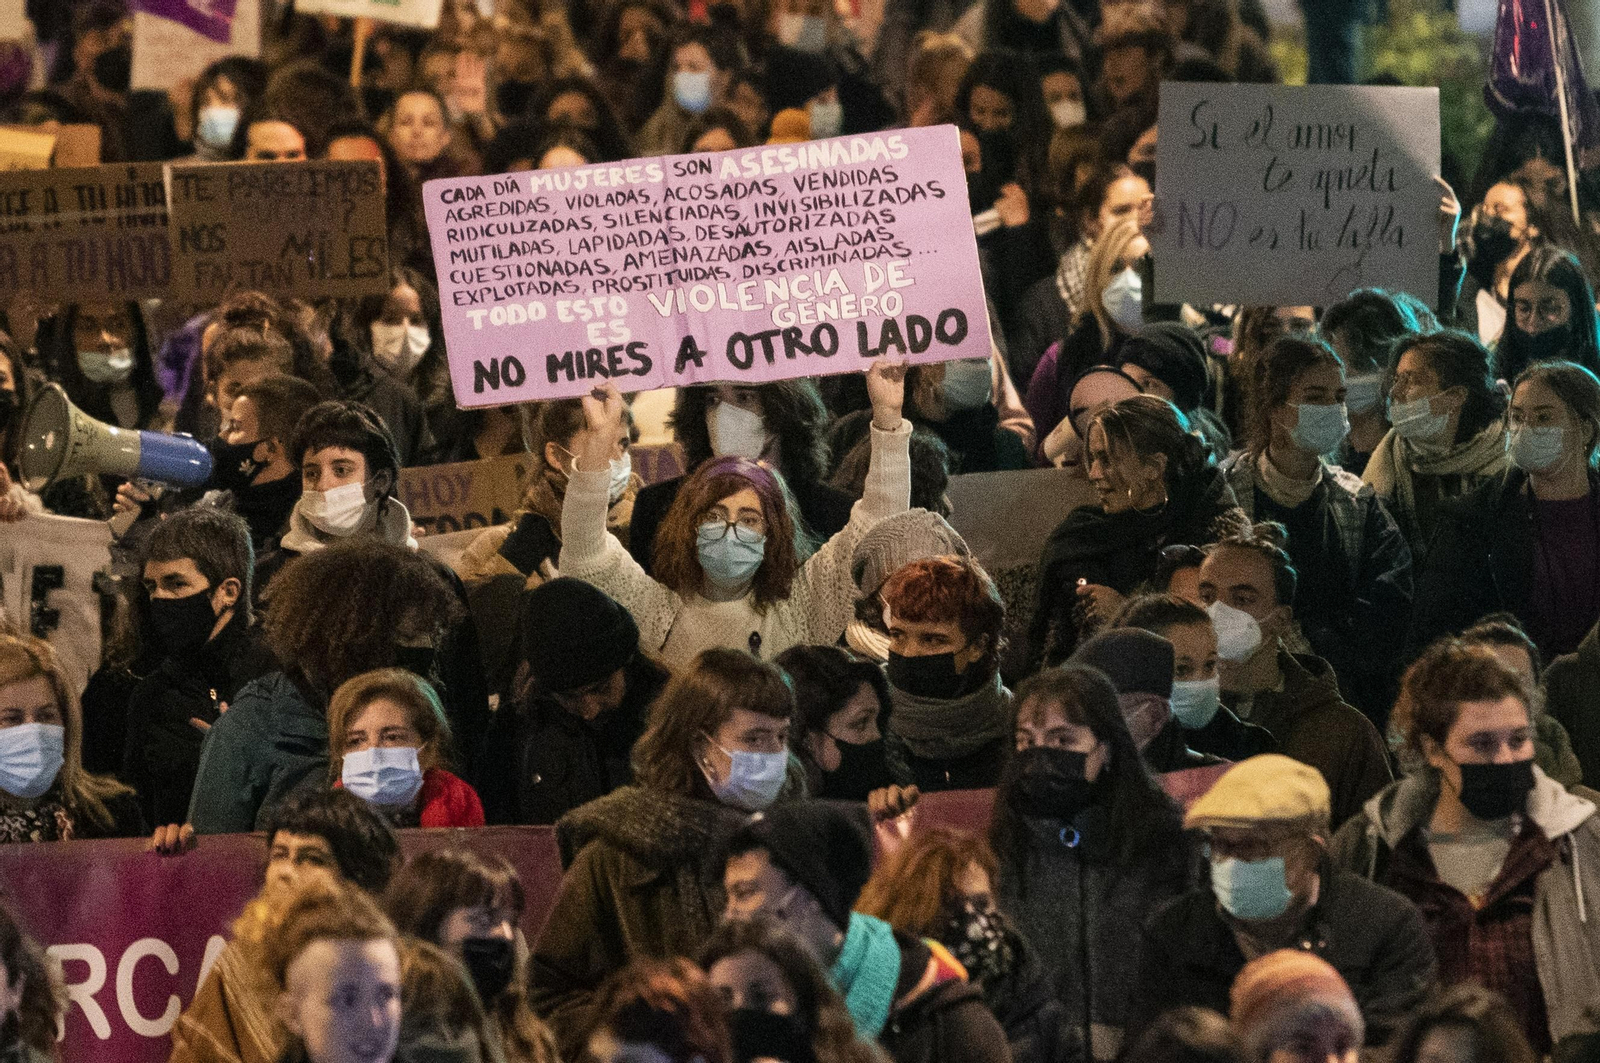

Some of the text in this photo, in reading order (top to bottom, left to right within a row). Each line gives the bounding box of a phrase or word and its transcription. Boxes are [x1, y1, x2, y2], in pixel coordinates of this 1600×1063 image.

[1189, 100, 1357, 151] Si el amor
[173, 167, 378, 201] TE PARECEMOS
[440, 135, 909, 205] CADA DÍA MUJERES SON ASESINADAS
[446, 165, 899, 223] AGREDIDAS, VIOLADAS, ACOSADAS, VENDIDAS
[1263, 155, 1293, 192] te
[447, 181, 946, 244] RIDICULIZADAS, SILENCIADAS, INVISIBILIZADAS
[450, 208, 896, 265] MUTILADAS, LAPIDADAS, DESAUTORIZADAS
[1178, 201, 1238, 250] NO
[1249, 227, 1280, 250] es
[180, 222, 226, 253] NOS
[449, 227, 895, 285] CUESTIONADAS, AMENAZADAS, AISLADAS
[453, 279, 588, 306] EXPLOTADAS,
[592, 266, 737, 294] PROSTITUIDAS,
[646, 259, 916, 318] VIOLENCIA DE
[771, 290, 905, 329] GÉNERO
[466, 295, 629, 330] TODO ESTO
[586, 319, 633, 346] ES
[472, 307, 969, 393] NO MIRES A OTRO LADO
[404, 471, 473, 512] HOY
